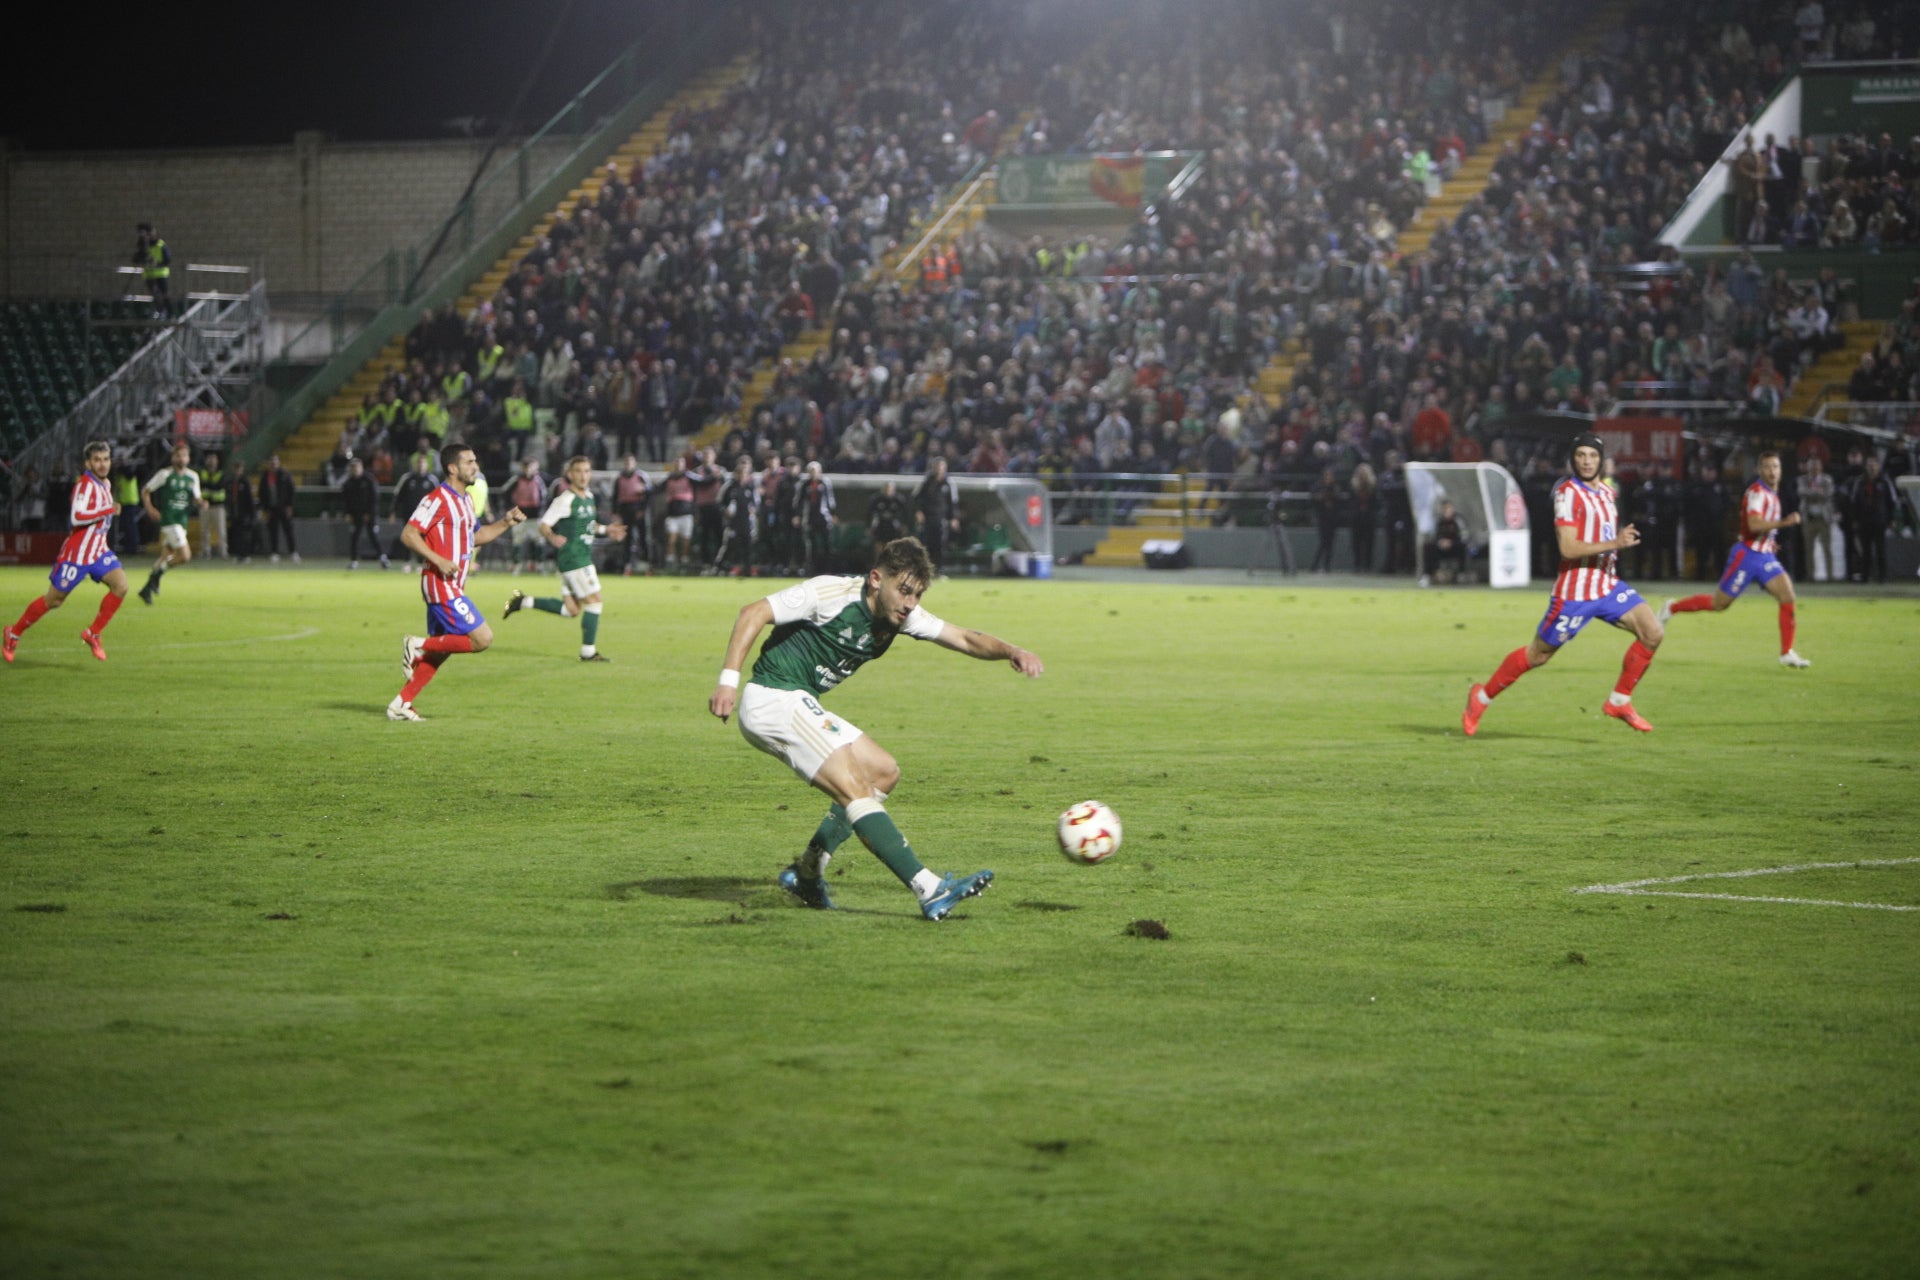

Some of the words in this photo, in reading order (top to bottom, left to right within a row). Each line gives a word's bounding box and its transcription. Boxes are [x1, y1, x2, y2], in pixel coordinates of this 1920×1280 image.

[62, 563, 78, 581] 10
[453, 597, 470, 616] 6
[1555, 614, 1584, 632] 24
